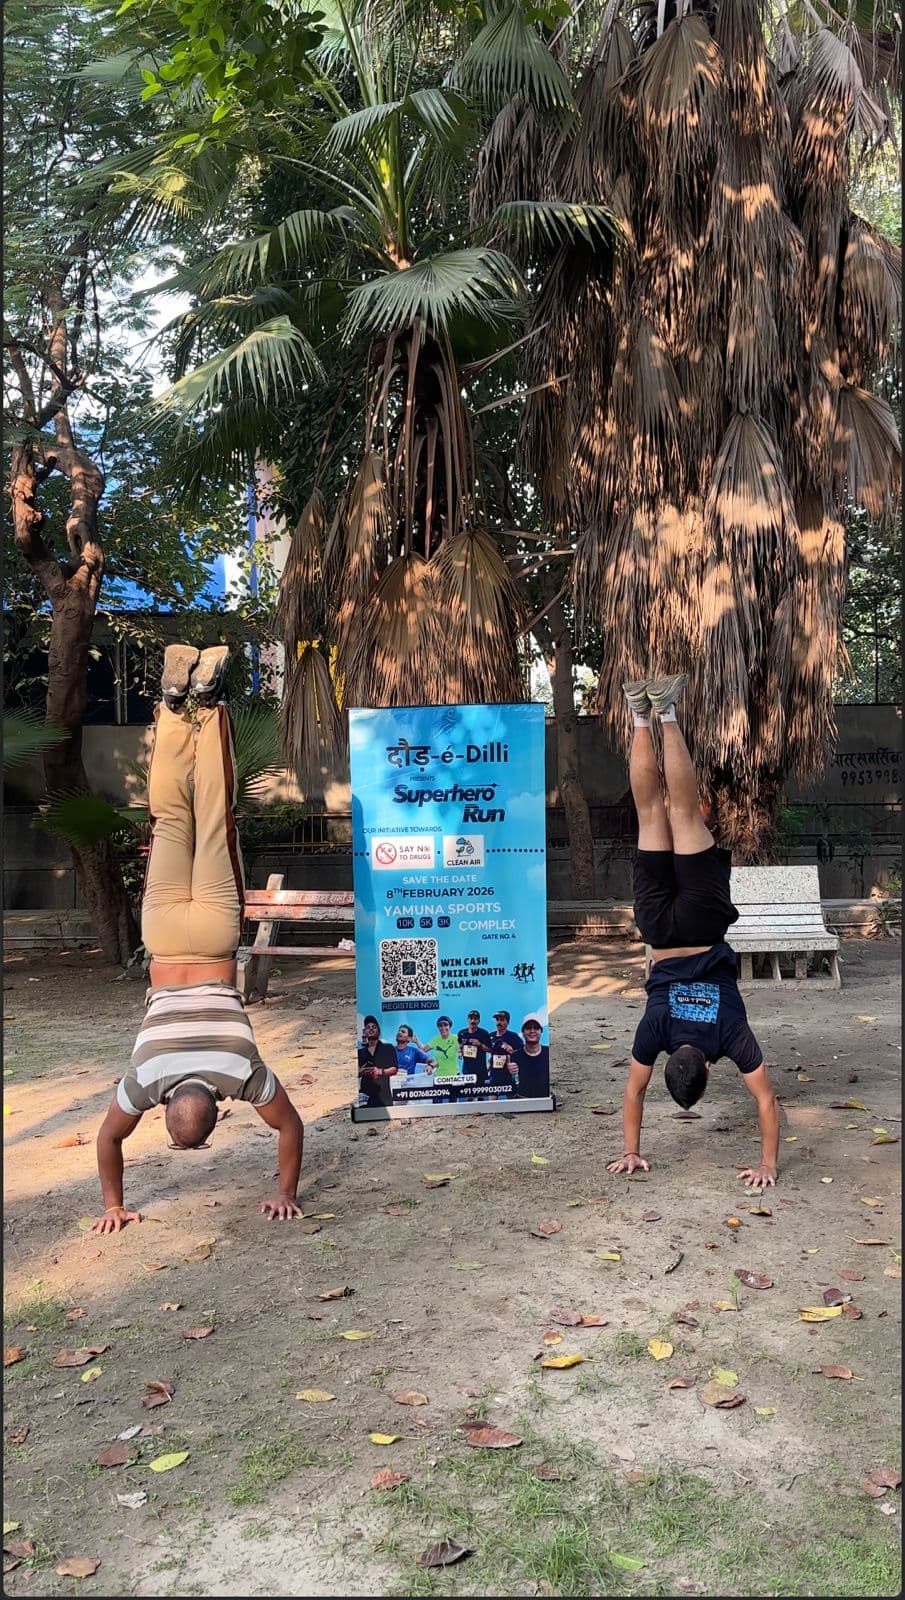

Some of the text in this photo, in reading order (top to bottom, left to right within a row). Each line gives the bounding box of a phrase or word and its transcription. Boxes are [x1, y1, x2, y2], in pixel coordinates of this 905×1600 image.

[392, 784, 499, 807] Superhero
[463, 804, 505, 823] Run
[402, 875, 477, 884] SAVE THE DATE
[467, 887, 494, 896] 2026
[384, 902, 501, 917] YAMUNA SPORTS
[397, 918, 450, 927] 10K 5K 3K
[459, 920, 515, 931] COMPLEX
[441, 957, 488, 967] WIN CASH
[441, 968, 505, 978] PRIZE WORTH
[382, 1001, 439, 1010] REGISTER NOW
